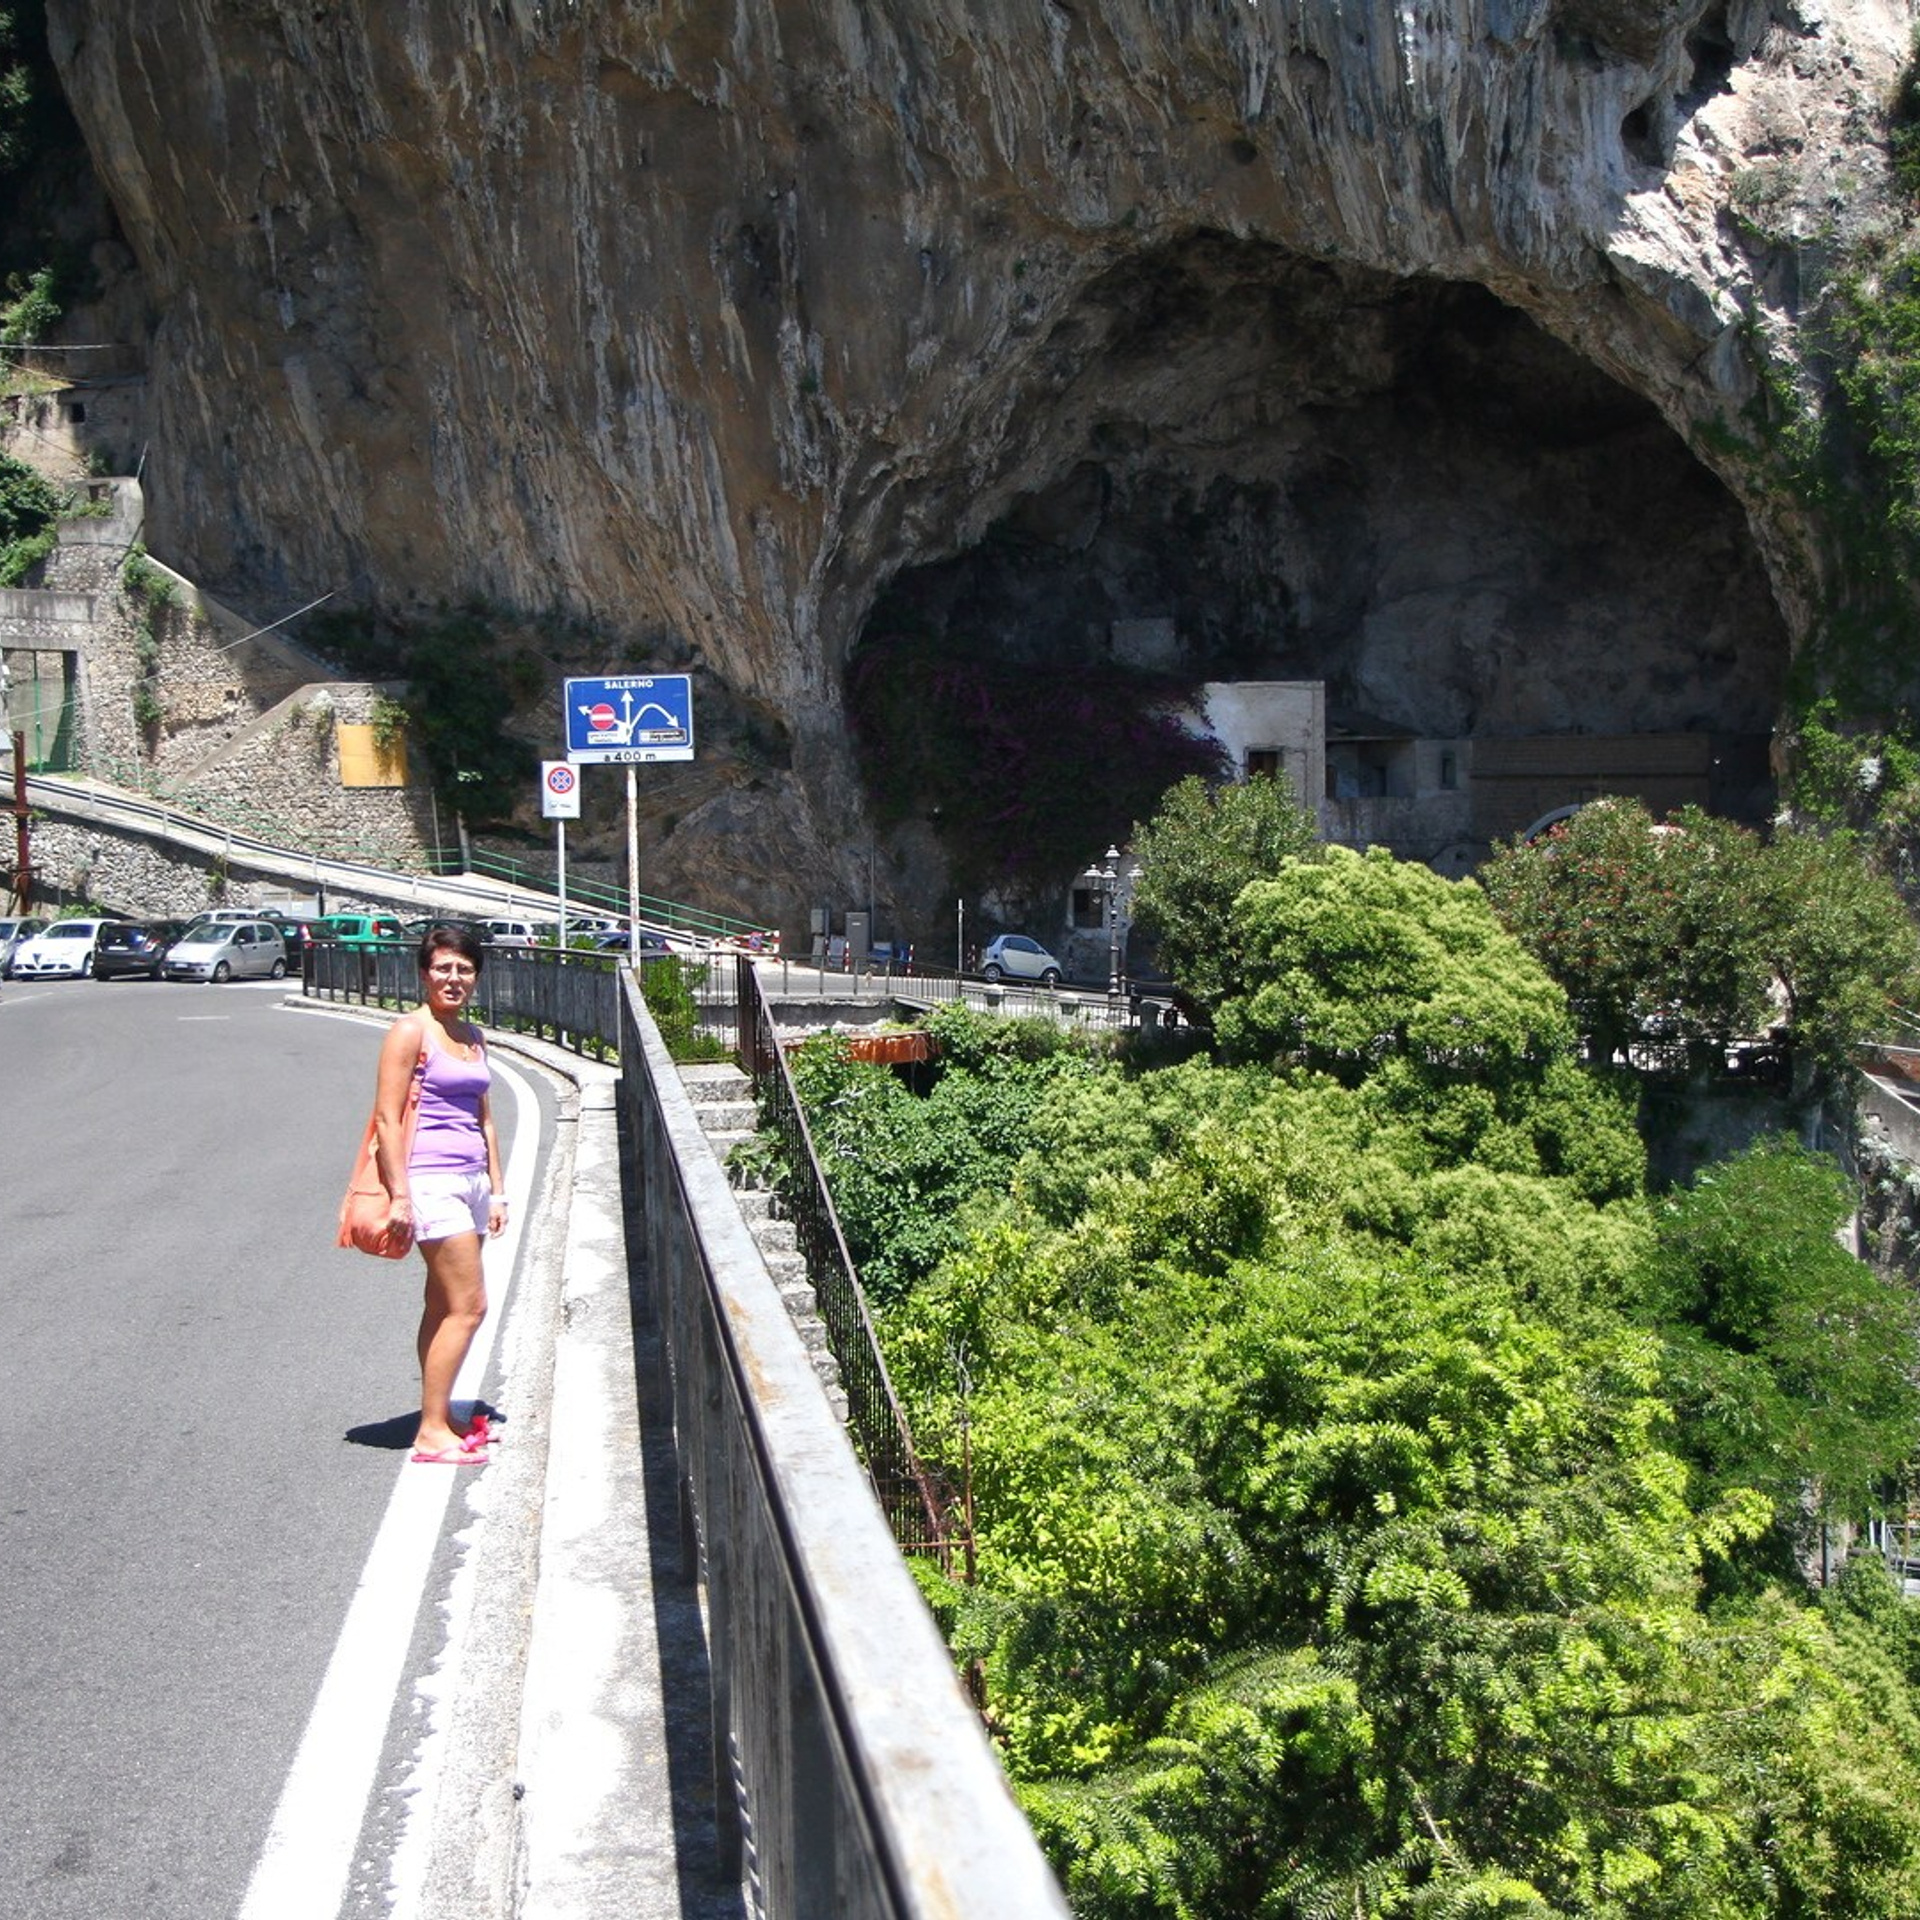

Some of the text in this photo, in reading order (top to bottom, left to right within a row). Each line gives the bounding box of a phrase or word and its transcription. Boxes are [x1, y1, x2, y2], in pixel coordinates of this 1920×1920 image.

[604, 679, 654, 690] SALERNO
[604, 751, 656, 762] a 400 m
